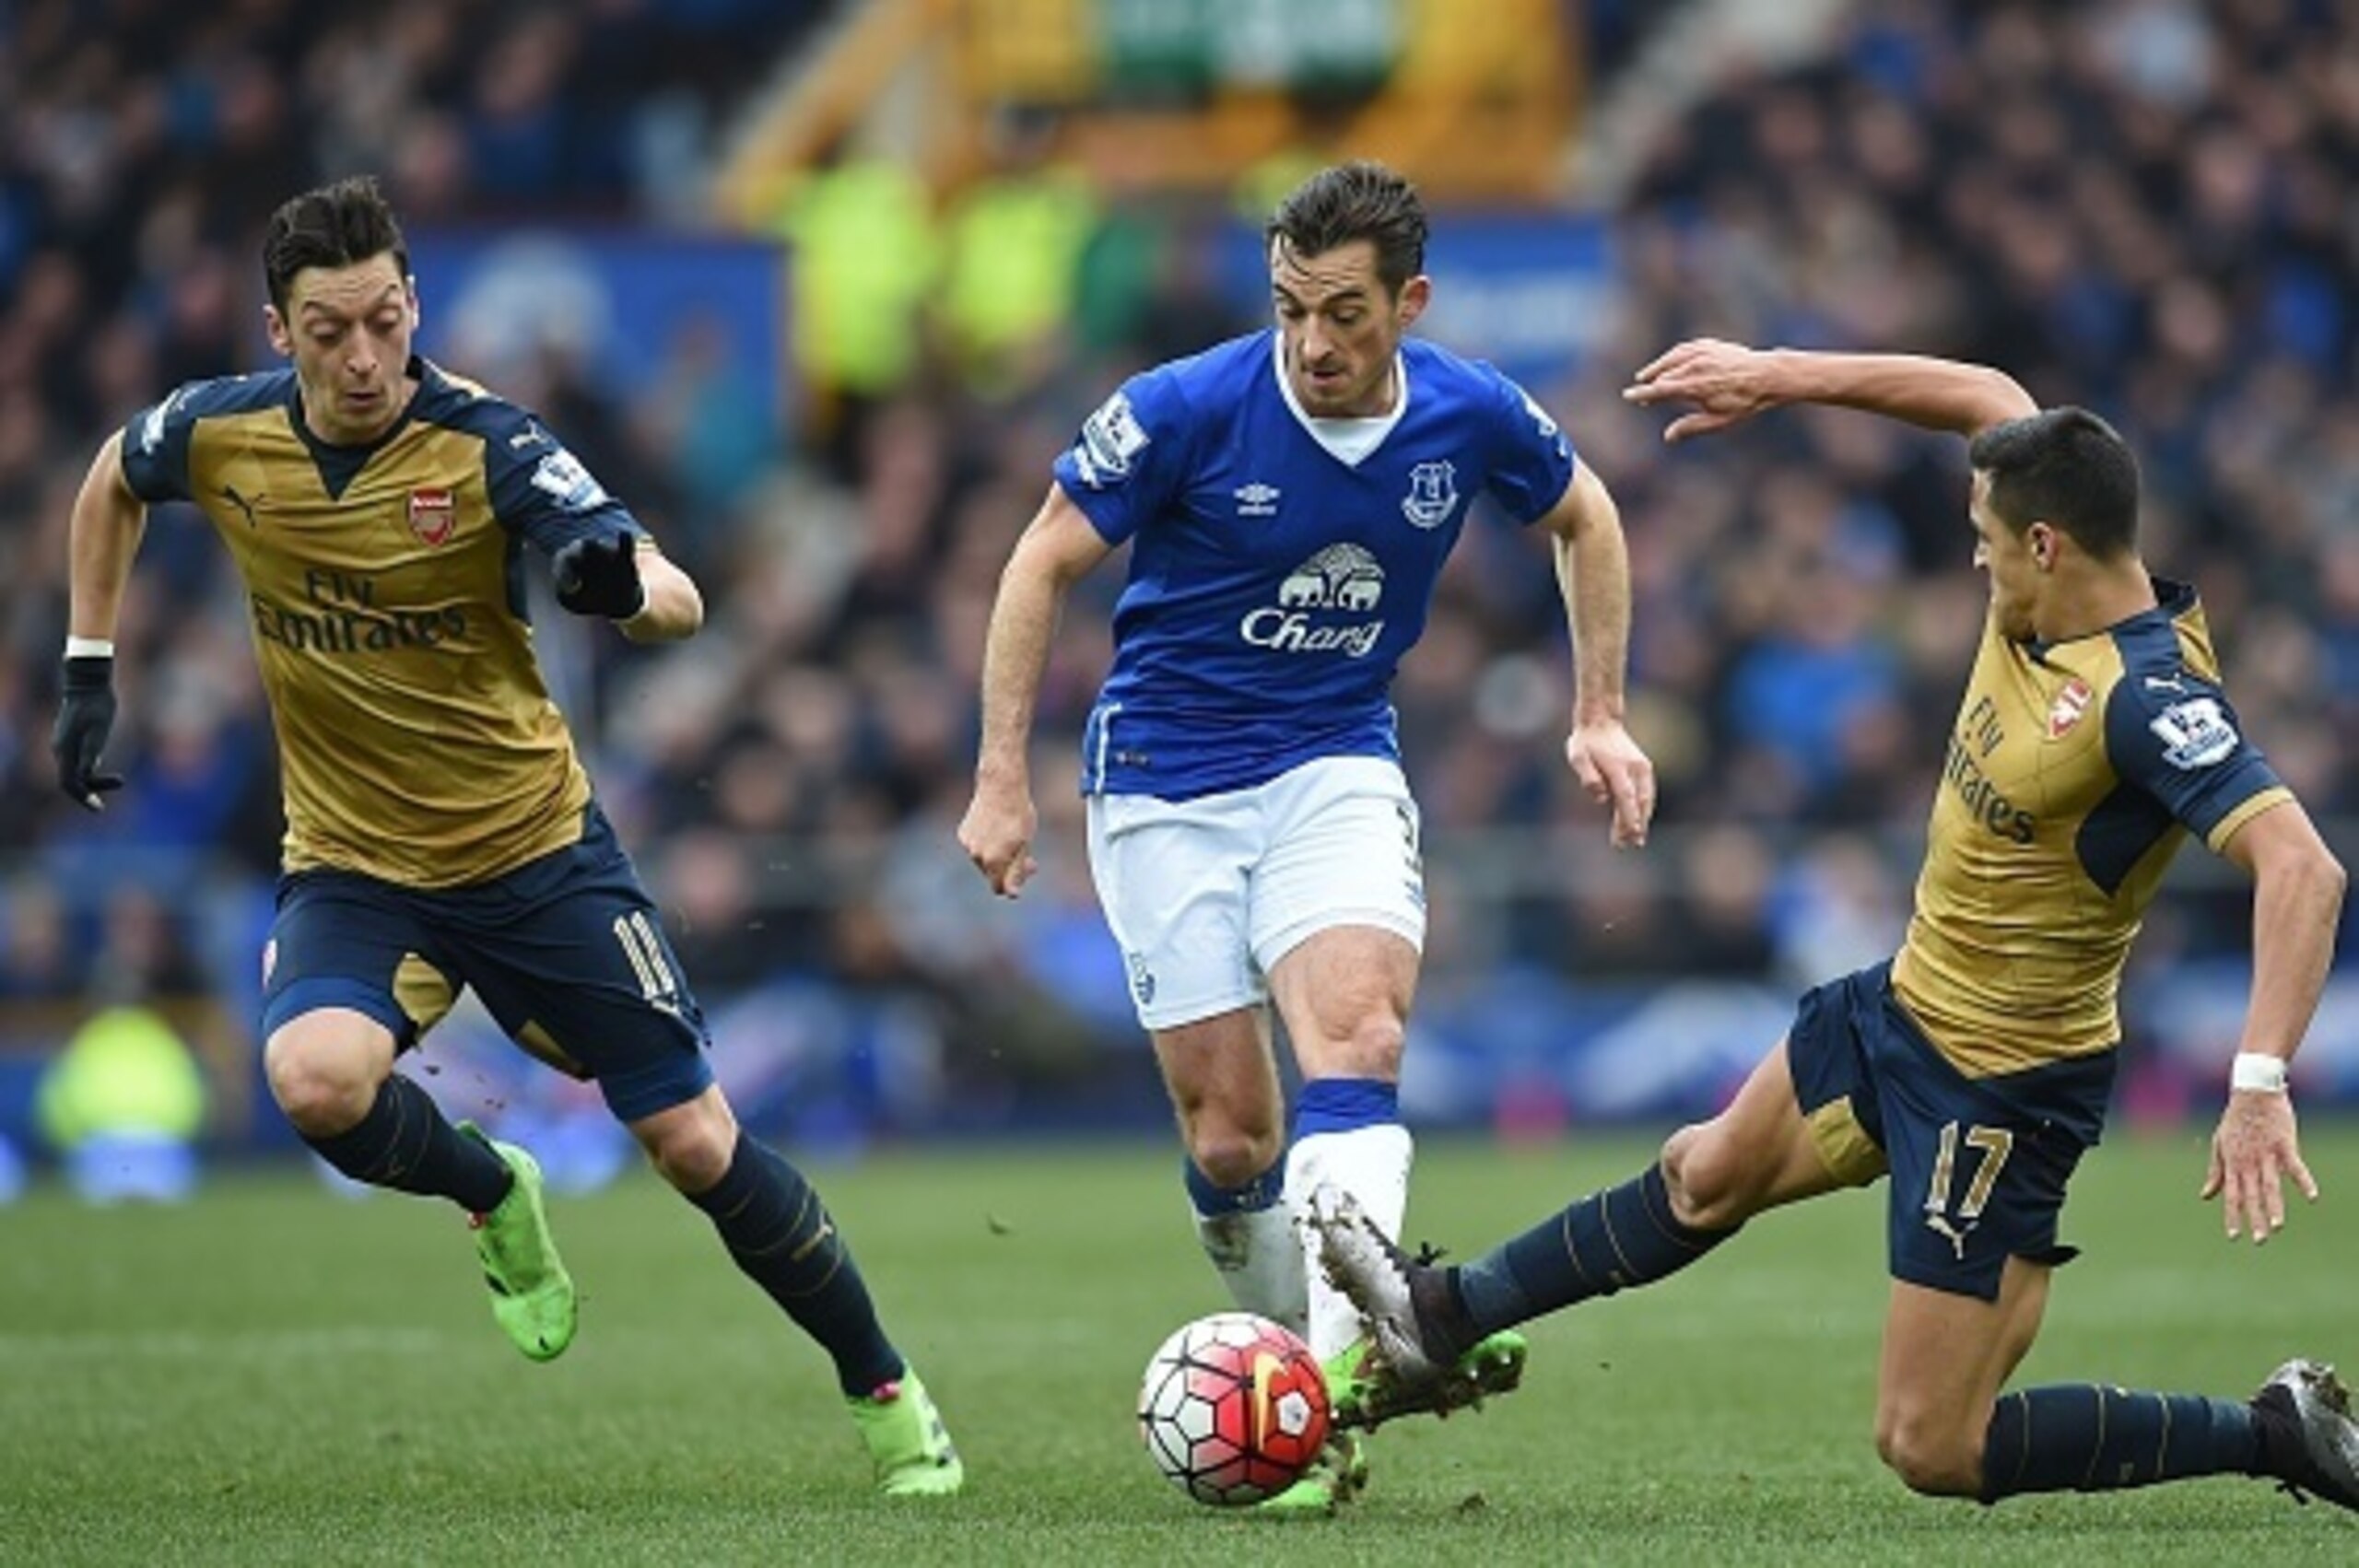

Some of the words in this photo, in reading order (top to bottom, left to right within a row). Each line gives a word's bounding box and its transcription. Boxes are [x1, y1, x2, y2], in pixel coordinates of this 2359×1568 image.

[1241, 607, 1384, 658] Chang
[613, 910, 675, 1000] 11
[1922, 1119, 2013, 1218] 17
